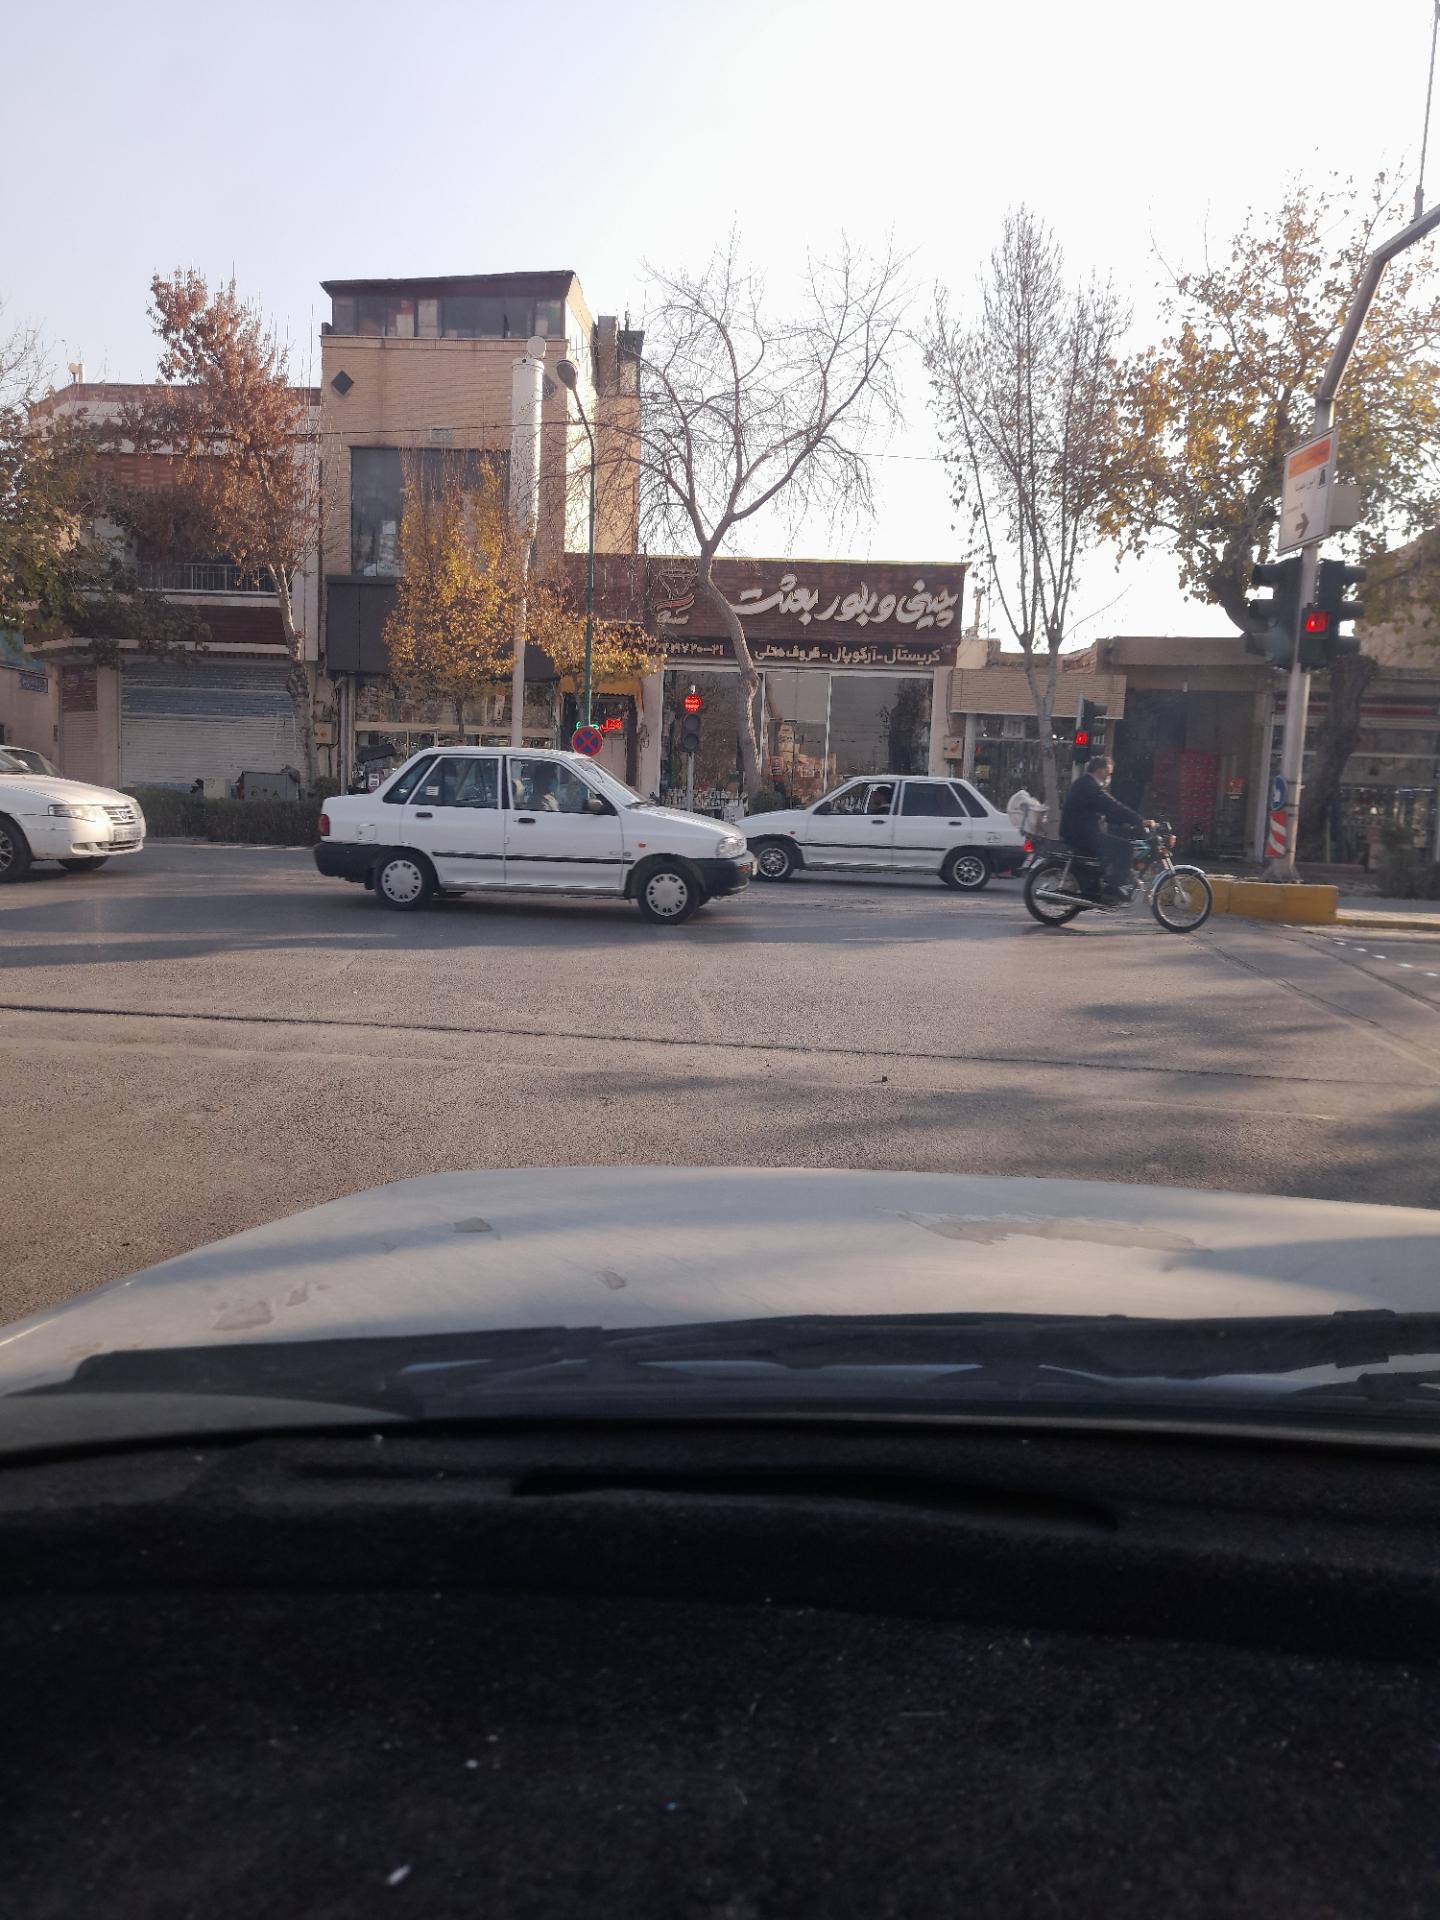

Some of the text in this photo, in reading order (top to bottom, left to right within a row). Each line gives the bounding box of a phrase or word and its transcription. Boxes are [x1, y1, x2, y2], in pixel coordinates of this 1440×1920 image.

[813, 580, 878, 627] بلور
[869, 594, 897, 623] و
[895, 579, 959, 630] چینی
